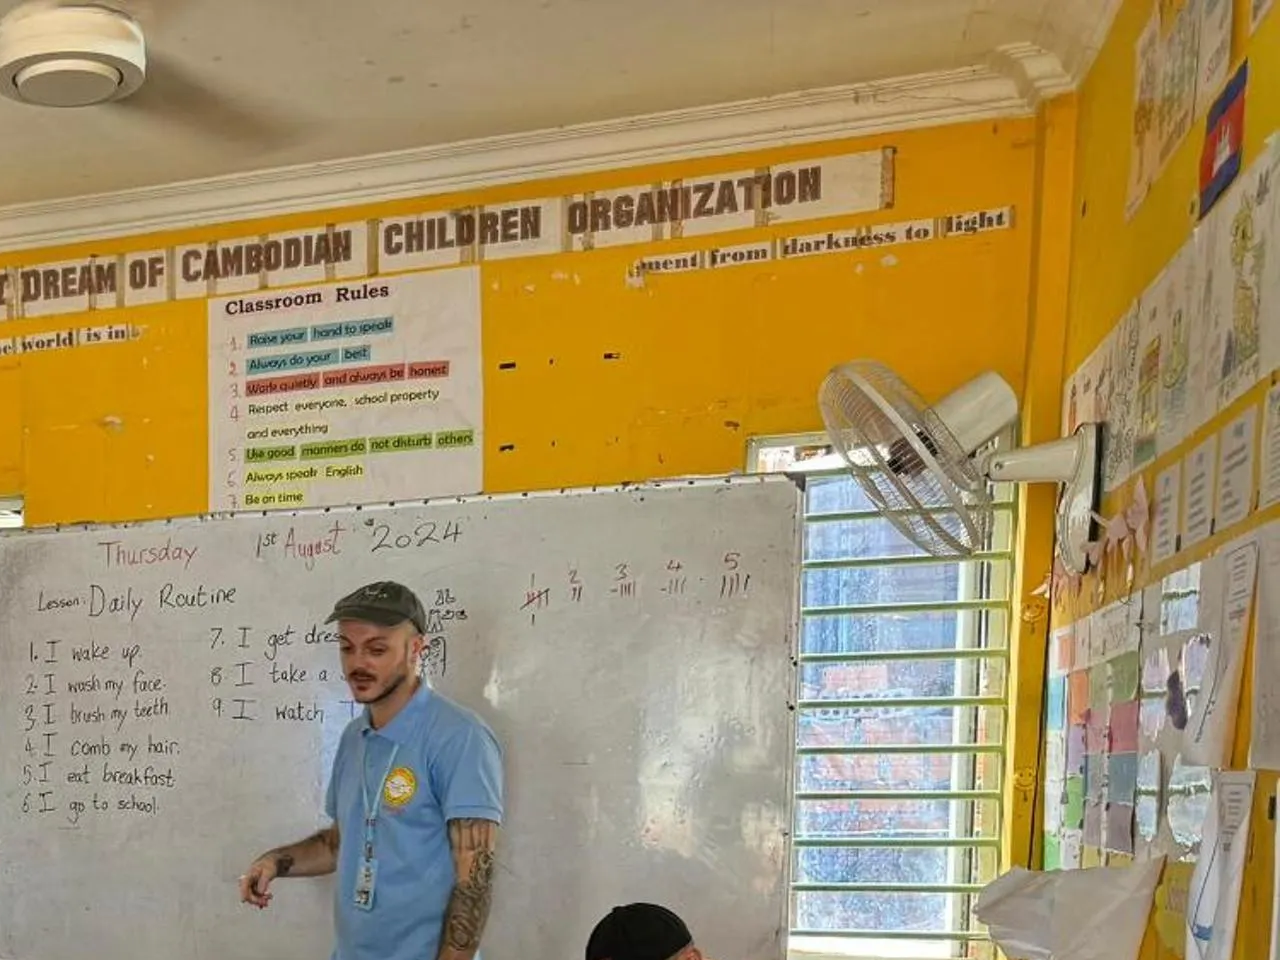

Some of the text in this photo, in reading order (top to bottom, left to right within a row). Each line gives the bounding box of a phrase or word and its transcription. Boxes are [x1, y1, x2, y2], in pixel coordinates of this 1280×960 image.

[22, 261, 117, 302] DREAM
[129, 257, 164, 289] OF
[182, 230, 352, 283] CAMBODIAN
[383, 206, 542, 255] CHILDREN
[568, 165, 822, 234] ORGANIZATION
[711, 247, 768, 267] from
[783, 231, 897, 257] darkness
[905, 224, 930, 241] to
[947, 211, 1005, 235] light
[225, 284, 389, 316] Classroom Rules
[21, 331, 73, 350] world
[87, 328, 101, 341] is
[108, 325, 125, 339] in
[250, 334, 278, 345] Raise
[280, 332, 305, 344] your
[314, 325, 342, 338] hand
[345, 324, 357, 335] to
[359, 321, 392, 334] speak
[249, 357, 287, 371] Always
[290, 354, 303, 366] do
[306, 352, 331, 366] your
[344, 348, 367, 360] best
[247, 382, 277, 395] Work
[279, 377, 317, 393] quietly
[324, 373, 346, 385] and
[349, 369, 387, 384] always
[390, 367, 404, 378] be
[410, 364, 446, 377] honest
[248, 402, 289, 417] Respect
[355, 392, 388, 405] school
[390, 389, 439, 404] property
[247, 422, 329, 440] and everything
[246, 448, 264, 461] Use
[267, 446, 295, 462] good
[301, 443, 348, 456] manners
[350, 441, 365, 453] do
[372, 438, 390, 449] not
[392, 435, 432, 448] disturb
[438, 432, 473, 446] others
[245, 470, 284, 485] Always
[286, 467, 318, 482] speak
[325, 464, 363, 479] English
[245, 493, 260, 506] Be
[262, 494, 276, 505] on
[278, 491, 304, 503] time
[99, 520, 463, 571] Thursday 1st August 2024
[568, 569, 581, 584] 2
[615, 563, 629, 581] 3
[667, 559, 682, 572] 4
[724, 552, 741, 571] 5
[38, 583, 236, 621] Lesson: Daily Routine
[29, 641, 38, 663] 1.
[44, 640, 62, 662] I
[72, 640, 109, 662] wake
[210, 624, 340, 660] 7. I get dres
[44, 673, 56, 695] I
[68, 674, 100, 693] wash
[105, 679, 123, 700] my
[234, 662, 254, 687] I
[269, 662, 307, 684] take
[319, 670, 328, 681] a
[42, 703, 56, 725] I
[71, 700, 105, 724] brush
[111, 708, 127, 732] my
[134, 696, 168, 718] teeth
[232, 699, 257, 720] I
[276, 701, 324, 723] watch
[339, 700, 354, 718] T
[42, 732, 58, 757] I
[71, 735, 110, 756] comb
[120, 743, 138, 761] my
[148, 734, 180, 755] hair.
[39, 761, 53, 782] I
[68, 765, 91, 784] eat
[39, 792, 56, 813] I
[67, 801, 85, 824] go
[93, 793, 109, 810] to
